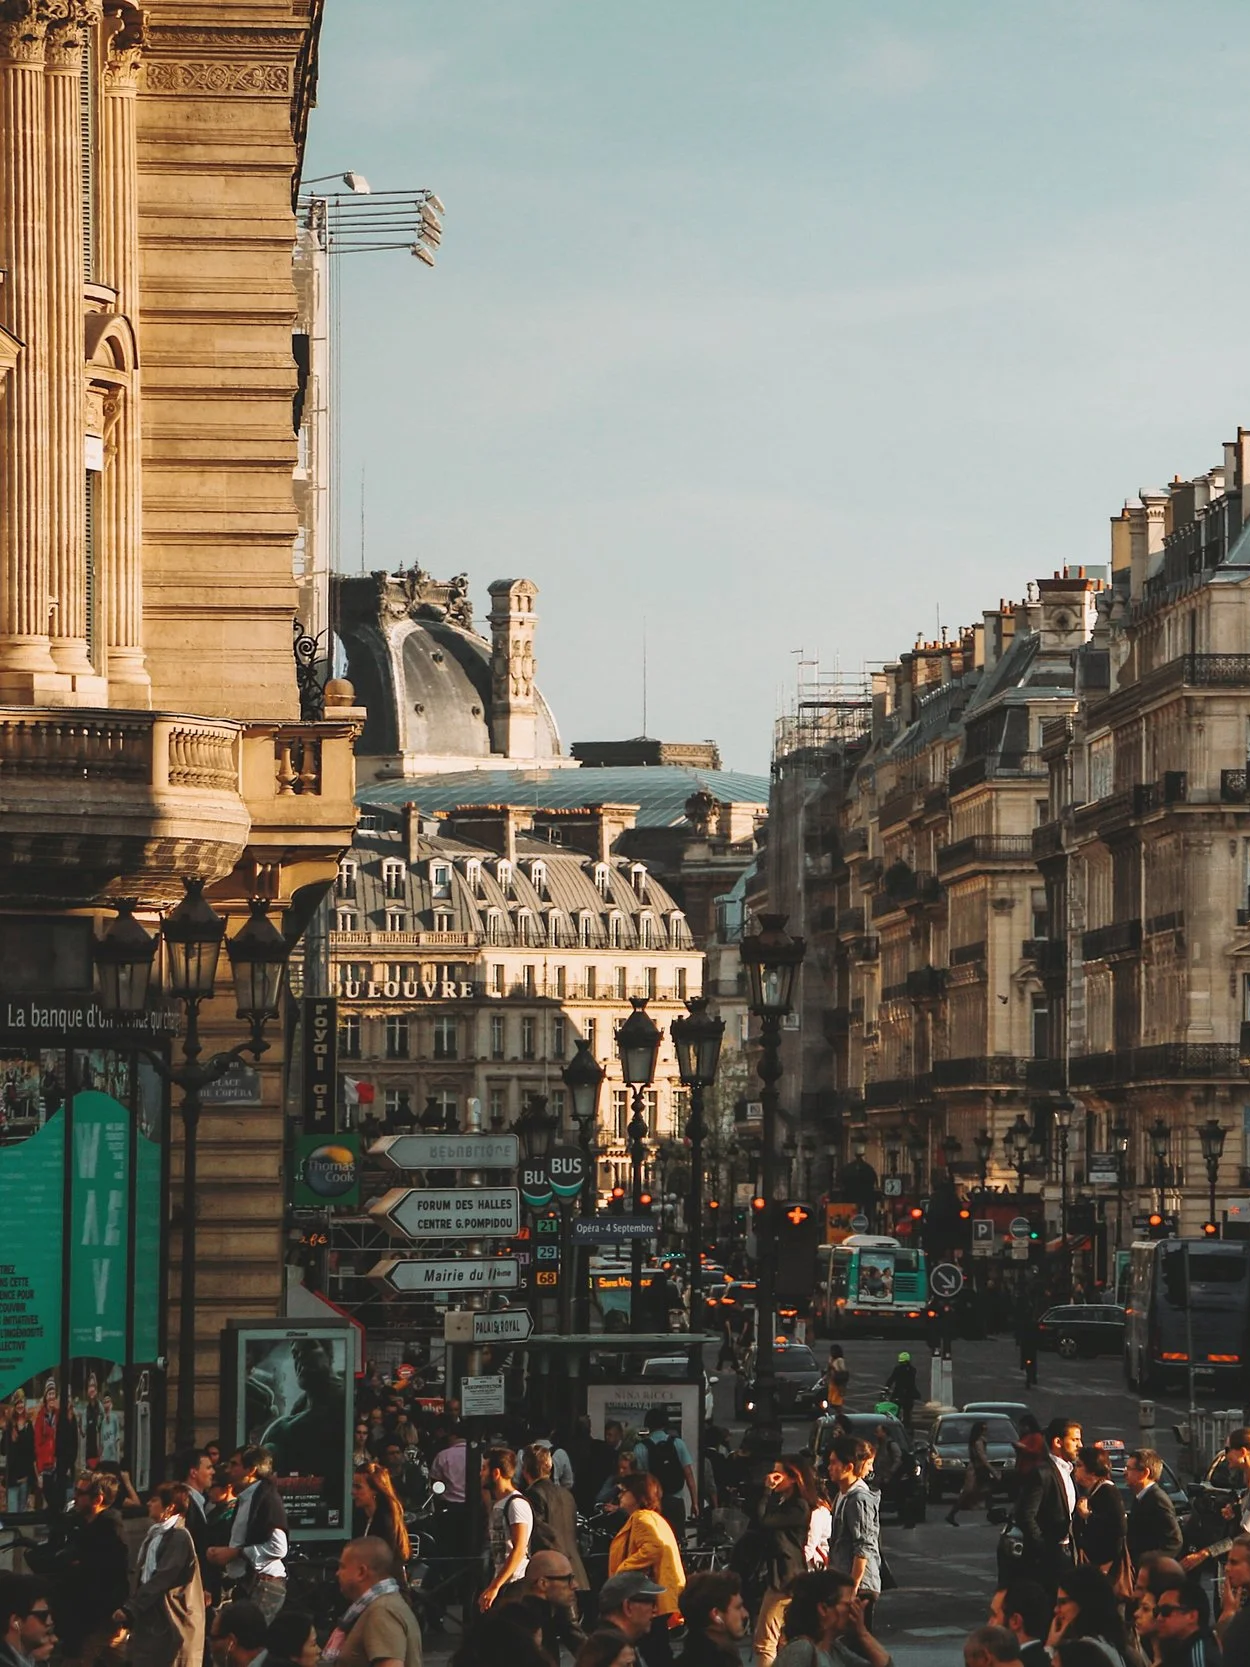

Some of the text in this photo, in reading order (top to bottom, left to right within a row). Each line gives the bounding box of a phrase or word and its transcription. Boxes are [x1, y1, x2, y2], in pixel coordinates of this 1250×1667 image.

[367, 981, 474, 999] LOUVRE
[7, 1003, 26, 1028] La
[31, 1002, 83, 1034] banque
[313, 1003, 328, 1121] royal air
[308, 1160, 355, 1172] Thomas
[551, 1158, 582, 1174] BUS
[324, 1171, 354, 1182] Cook
[524, 1170, 548, 1185] BU
[417, 1198, 512, 1210] FORUM DES HALLES
[417, 1218, 452, 1229] CENTRE
[541, 1221, 554, 1232] 21
[576, 1223, 600, 1235] Opéra
[605, 1224, 612, 1233] 4
[613, 1223, 655, 1235] Septembre
[978, 1223, 988, 1238] P
[540, 1247, 555, 1258] 29
[424, 1268, 465, 1282] Mairie
[470, 1268, 483, 1281] du
[539, 1273, 554, 1284] 68
[501, 1319, 520, 1332] ROYAL
